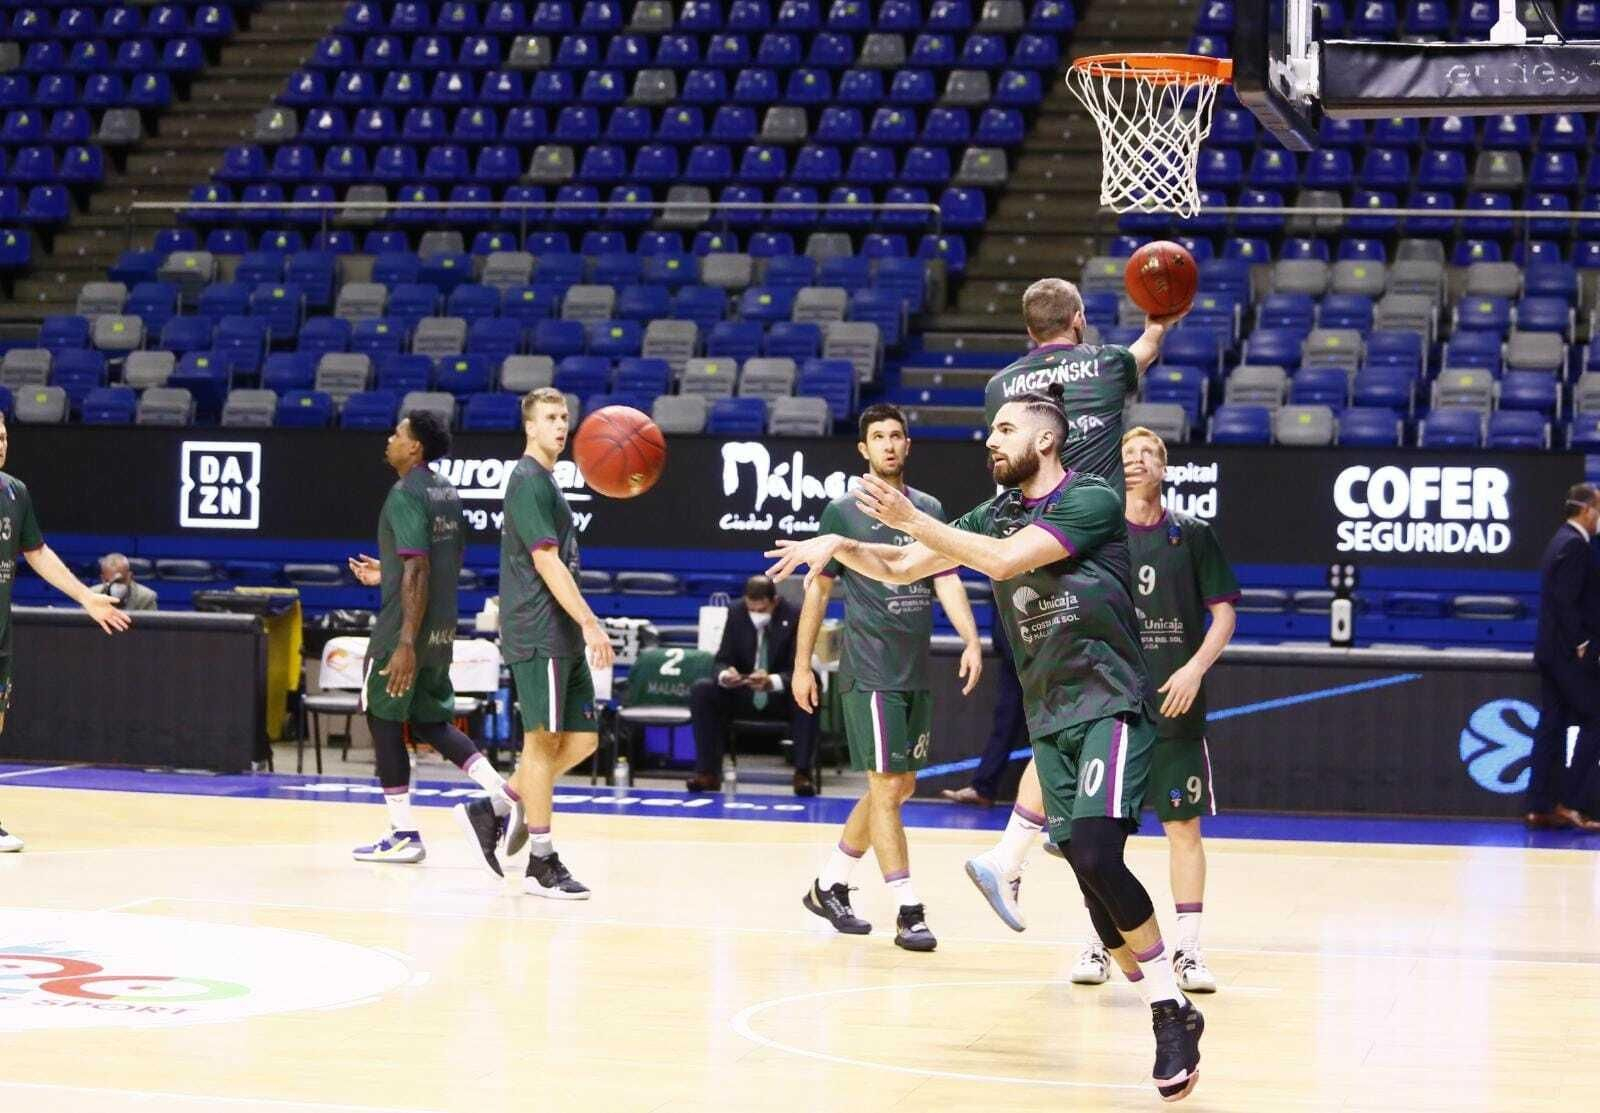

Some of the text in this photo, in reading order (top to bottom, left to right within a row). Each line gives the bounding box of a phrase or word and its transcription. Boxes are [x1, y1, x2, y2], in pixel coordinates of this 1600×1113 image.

[1333, 464, 1511, 520] COFER
[1336, 520, 1512, 554] SEGURIDAD
[1138, 564, 1156, 596] 9
[1038, 590, 1081, 611] Unicaja
[1144, 617, 1184, 633] Unicaja
[659, 647, 685, 677] 2
[1185, 775, 1202, 805] 9
